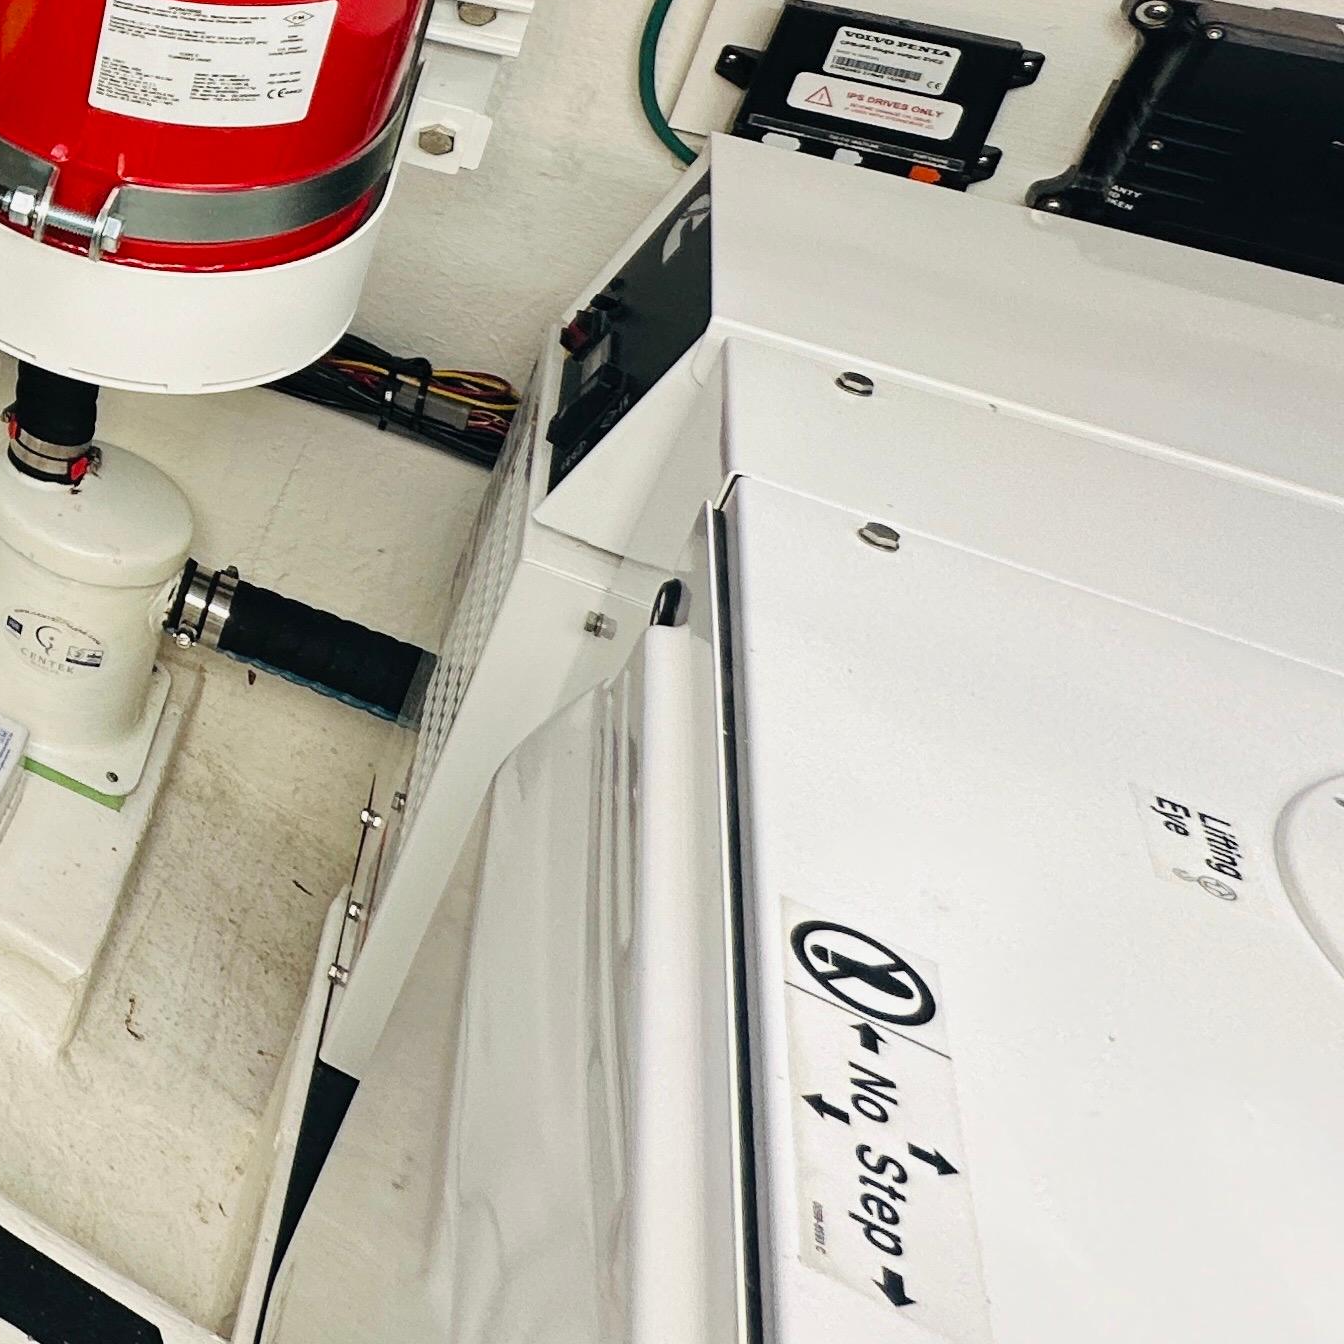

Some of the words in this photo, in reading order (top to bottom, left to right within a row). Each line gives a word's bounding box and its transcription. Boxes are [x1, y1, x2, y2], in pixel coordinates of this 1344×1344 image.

[844, 31, 895, 46] VOLVO
[897, 41, 952, 58] PENTA
[847, 91, 865, 102] IPS
[867, 96, 909, 112] DRIVES
[911, 106, 945, 118] ONLY
[20, 646, 75, 675] CENTEK
[1150, 795, 1192, 837] Eye
[1197, 811, 1244, 881] Lifting
[847, 1059, 899, 1124] No
[847, 1142, 909, 1257] Step
